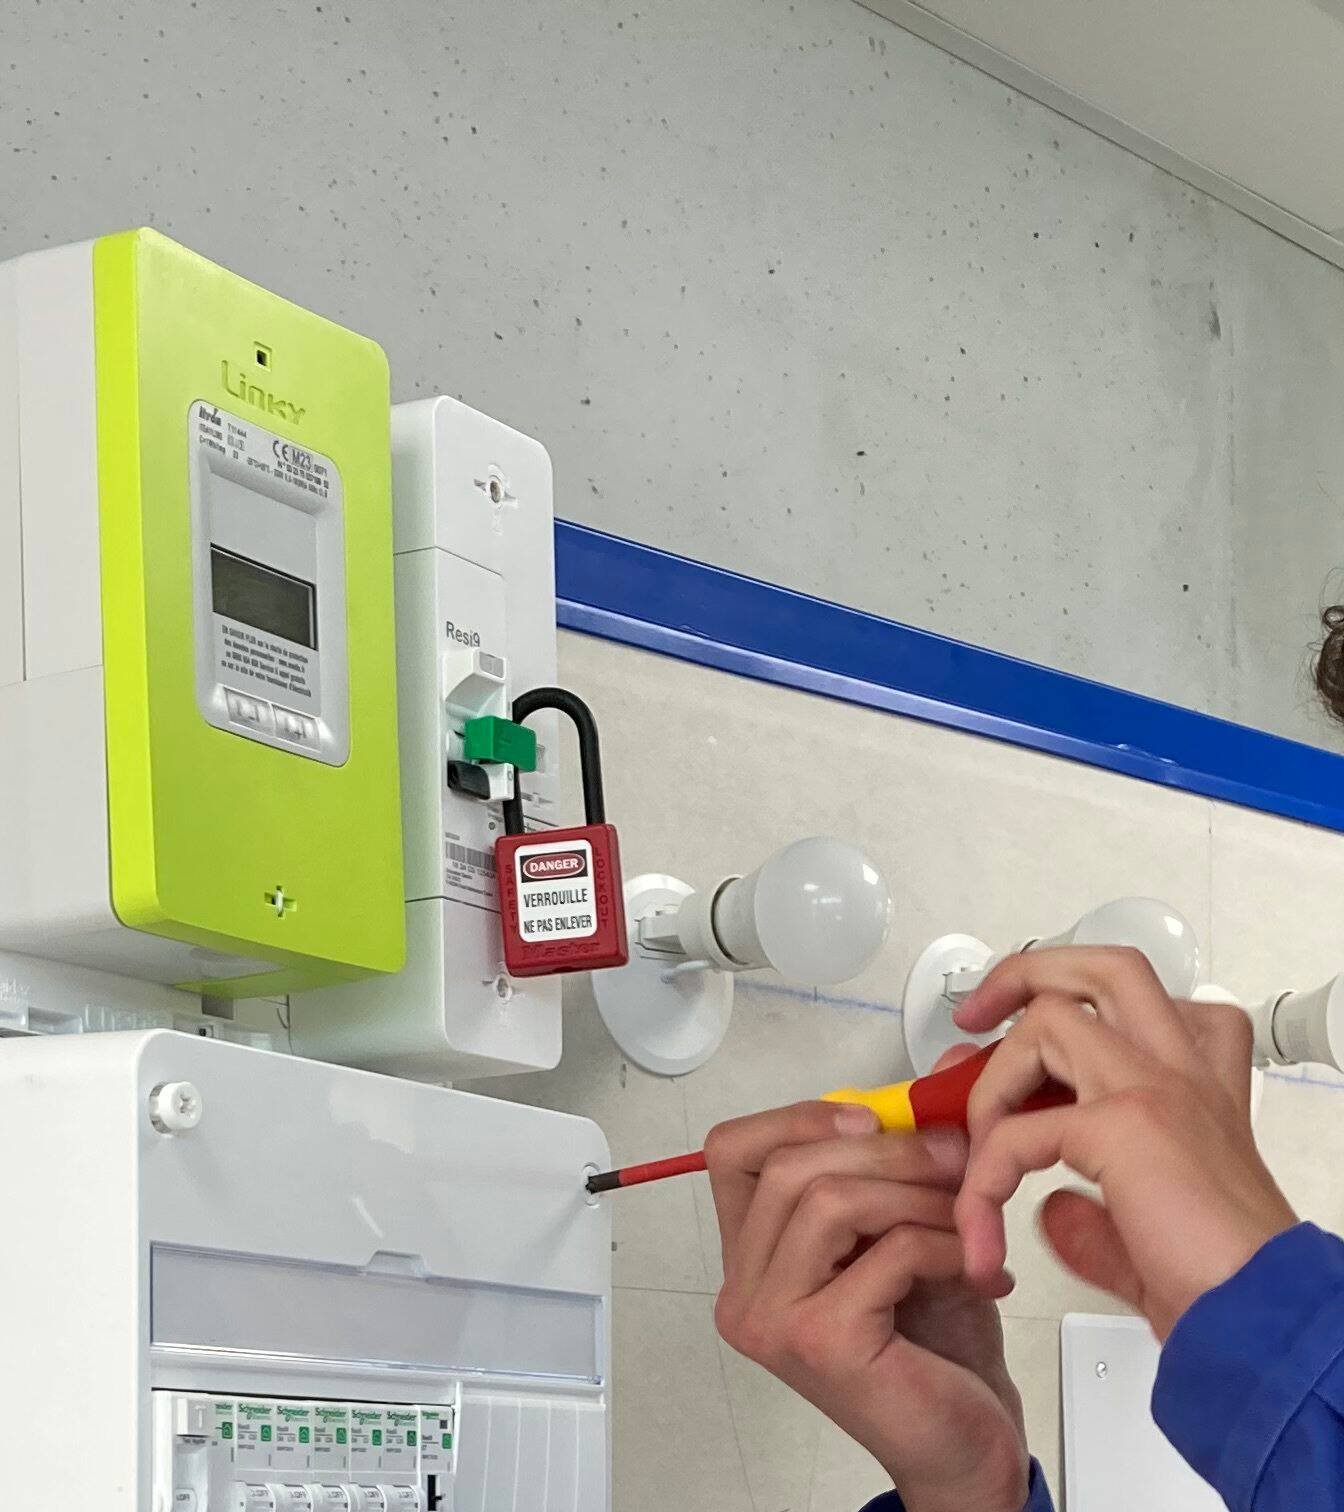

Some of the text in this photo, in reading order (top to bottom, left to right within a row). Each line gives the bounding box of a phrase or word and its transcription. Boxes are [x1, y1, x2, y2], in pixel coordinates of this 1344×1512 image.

[446, 621, 481, 648] Resi9
[529, 858, 579, 873] DANGER
[523, 888, 588, 908] VERROUILLE
[523, 915, 593, 934] NE PAS ENLEVER
